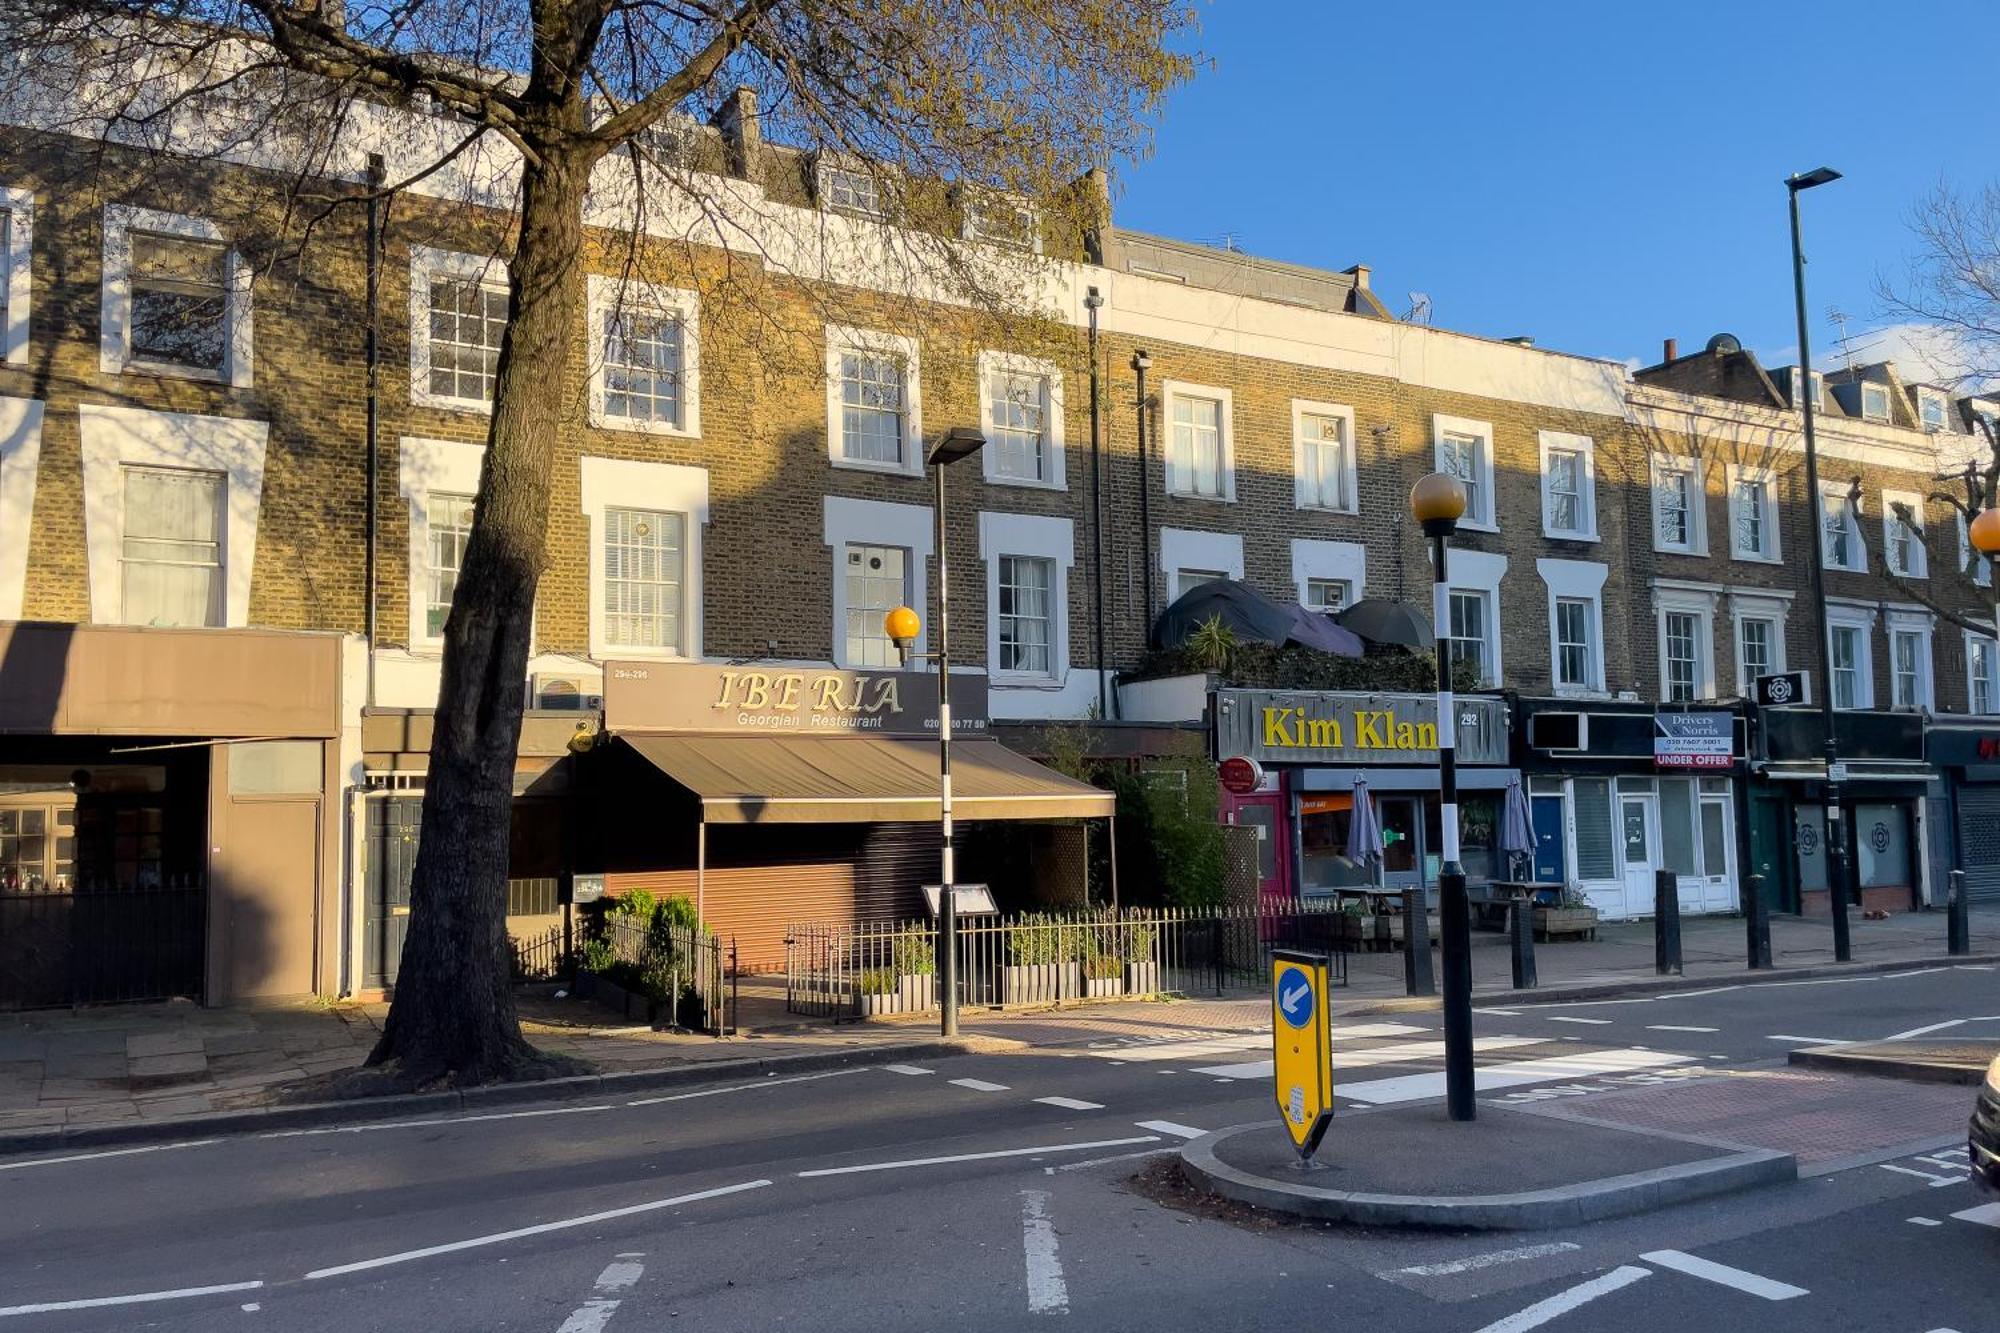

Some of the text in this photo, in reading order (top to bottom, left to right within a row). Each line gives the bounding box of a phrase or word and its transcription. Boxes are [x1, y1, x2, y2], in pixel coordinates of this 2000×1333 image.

[712, 671, 903, 713] IBERIA
[737, 712, 882, 729] Georgian Restaurant
[1461, 713, 1477, 726] 292
[1672, 715, 1714, 725] Drivers
[1262, 706, 1440, 750] Kim Klan
[1682, 725, 1719, 736] Norris
[1657, 755, 1728, 765] UNDER OFFER
